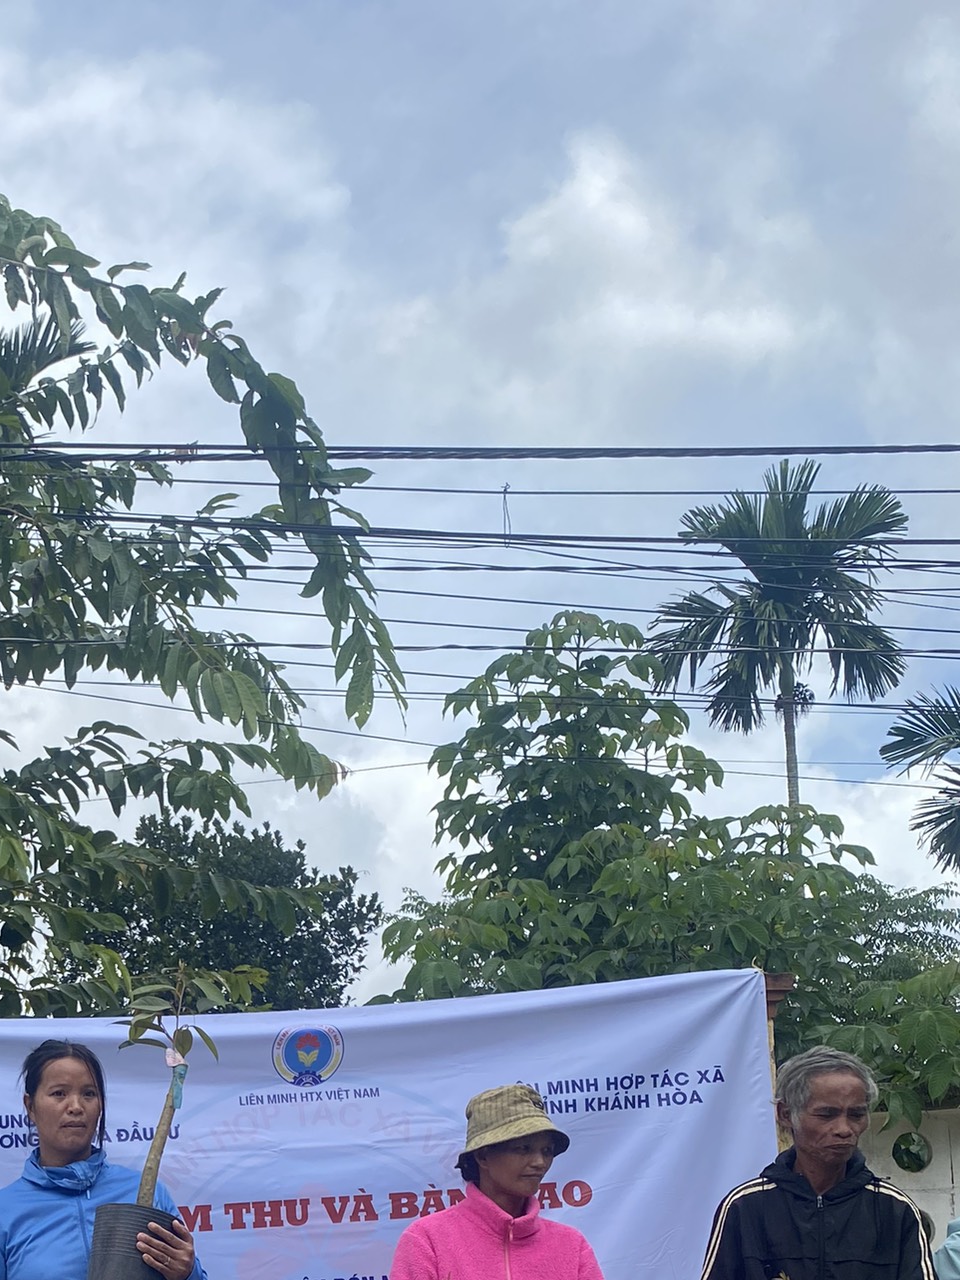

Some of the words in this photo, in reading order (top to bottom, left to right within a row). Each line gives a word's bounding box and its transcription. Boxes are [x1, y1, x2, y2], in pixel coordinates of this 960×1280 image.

[547, 1078, 599, 1095] MINH
[606, 1073, 646, 1095] HỢP
[651, 1069, 690, 1089] TÁC
[697, 1065, 725, 1085] XÃ
[239, 1093, 264, 1107] LIÊN
[267, 1093, 297, 1105] MINH
[300, 1091, 323, 1103] HTX
[325, 1087, 351, 1102] VIỆT
[353, 1087, 380, 1099] NAM
[542, 1096, 577, 1115] ỈNH
[585, 1093, 650, 1112] KHÁNH
[657, 1088, 703, 1107] HÒA
[116, 1120, 154, 1142] ĐẦU
[224, 1198, 310, 1230] THU
[321, 1187, 379, 1224] VÀ
